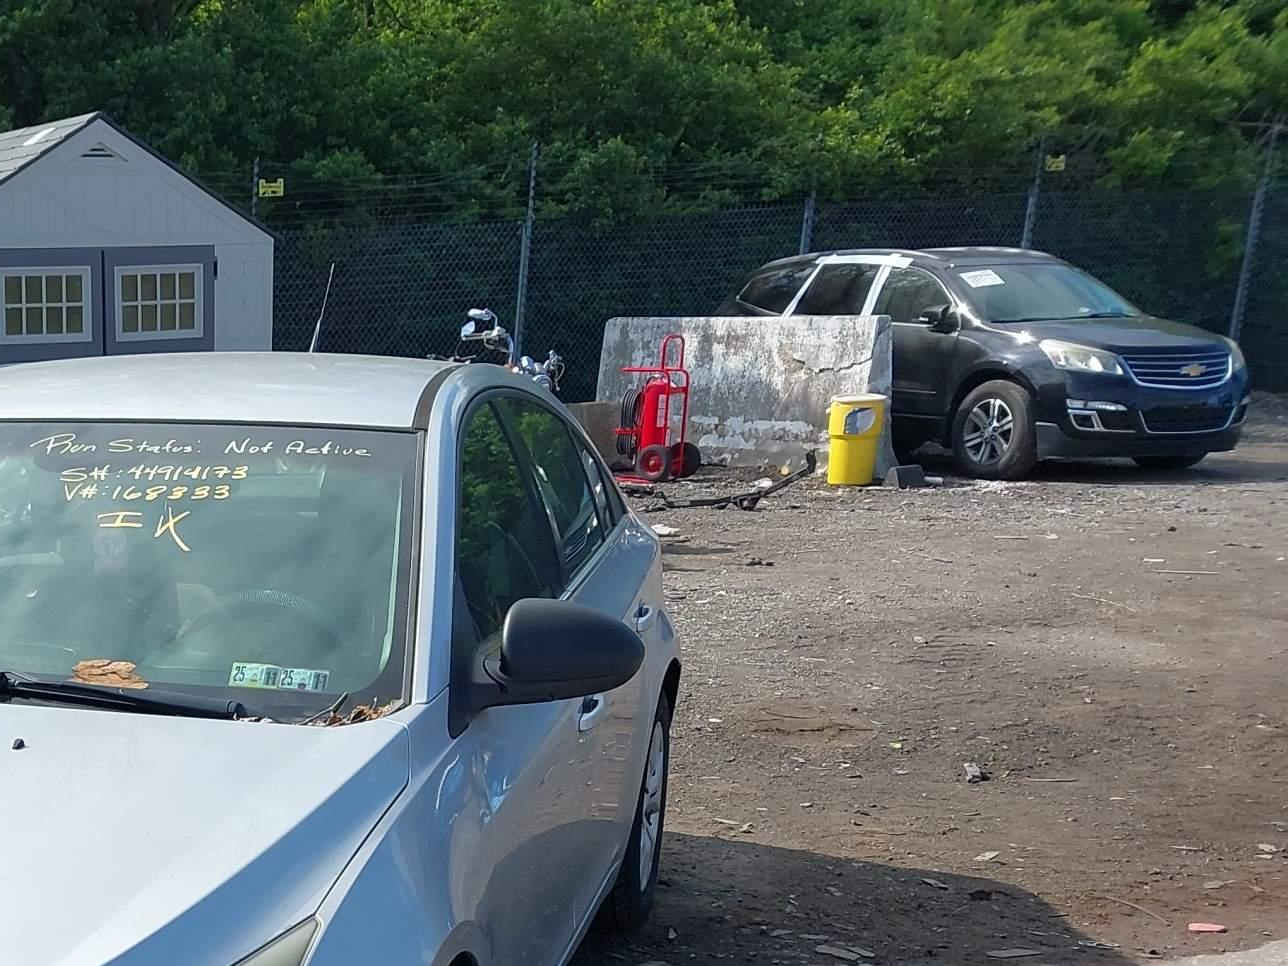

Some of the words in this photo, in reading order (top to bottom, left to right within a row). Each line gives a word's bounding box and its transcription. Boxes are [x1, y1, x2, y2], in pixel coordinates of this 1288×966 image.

[223, 437, 274, 455] Not
[285, 440, 372, 457] Active
[233, 665, 246, 682] 25
[281, 669, 295, 686] 25
